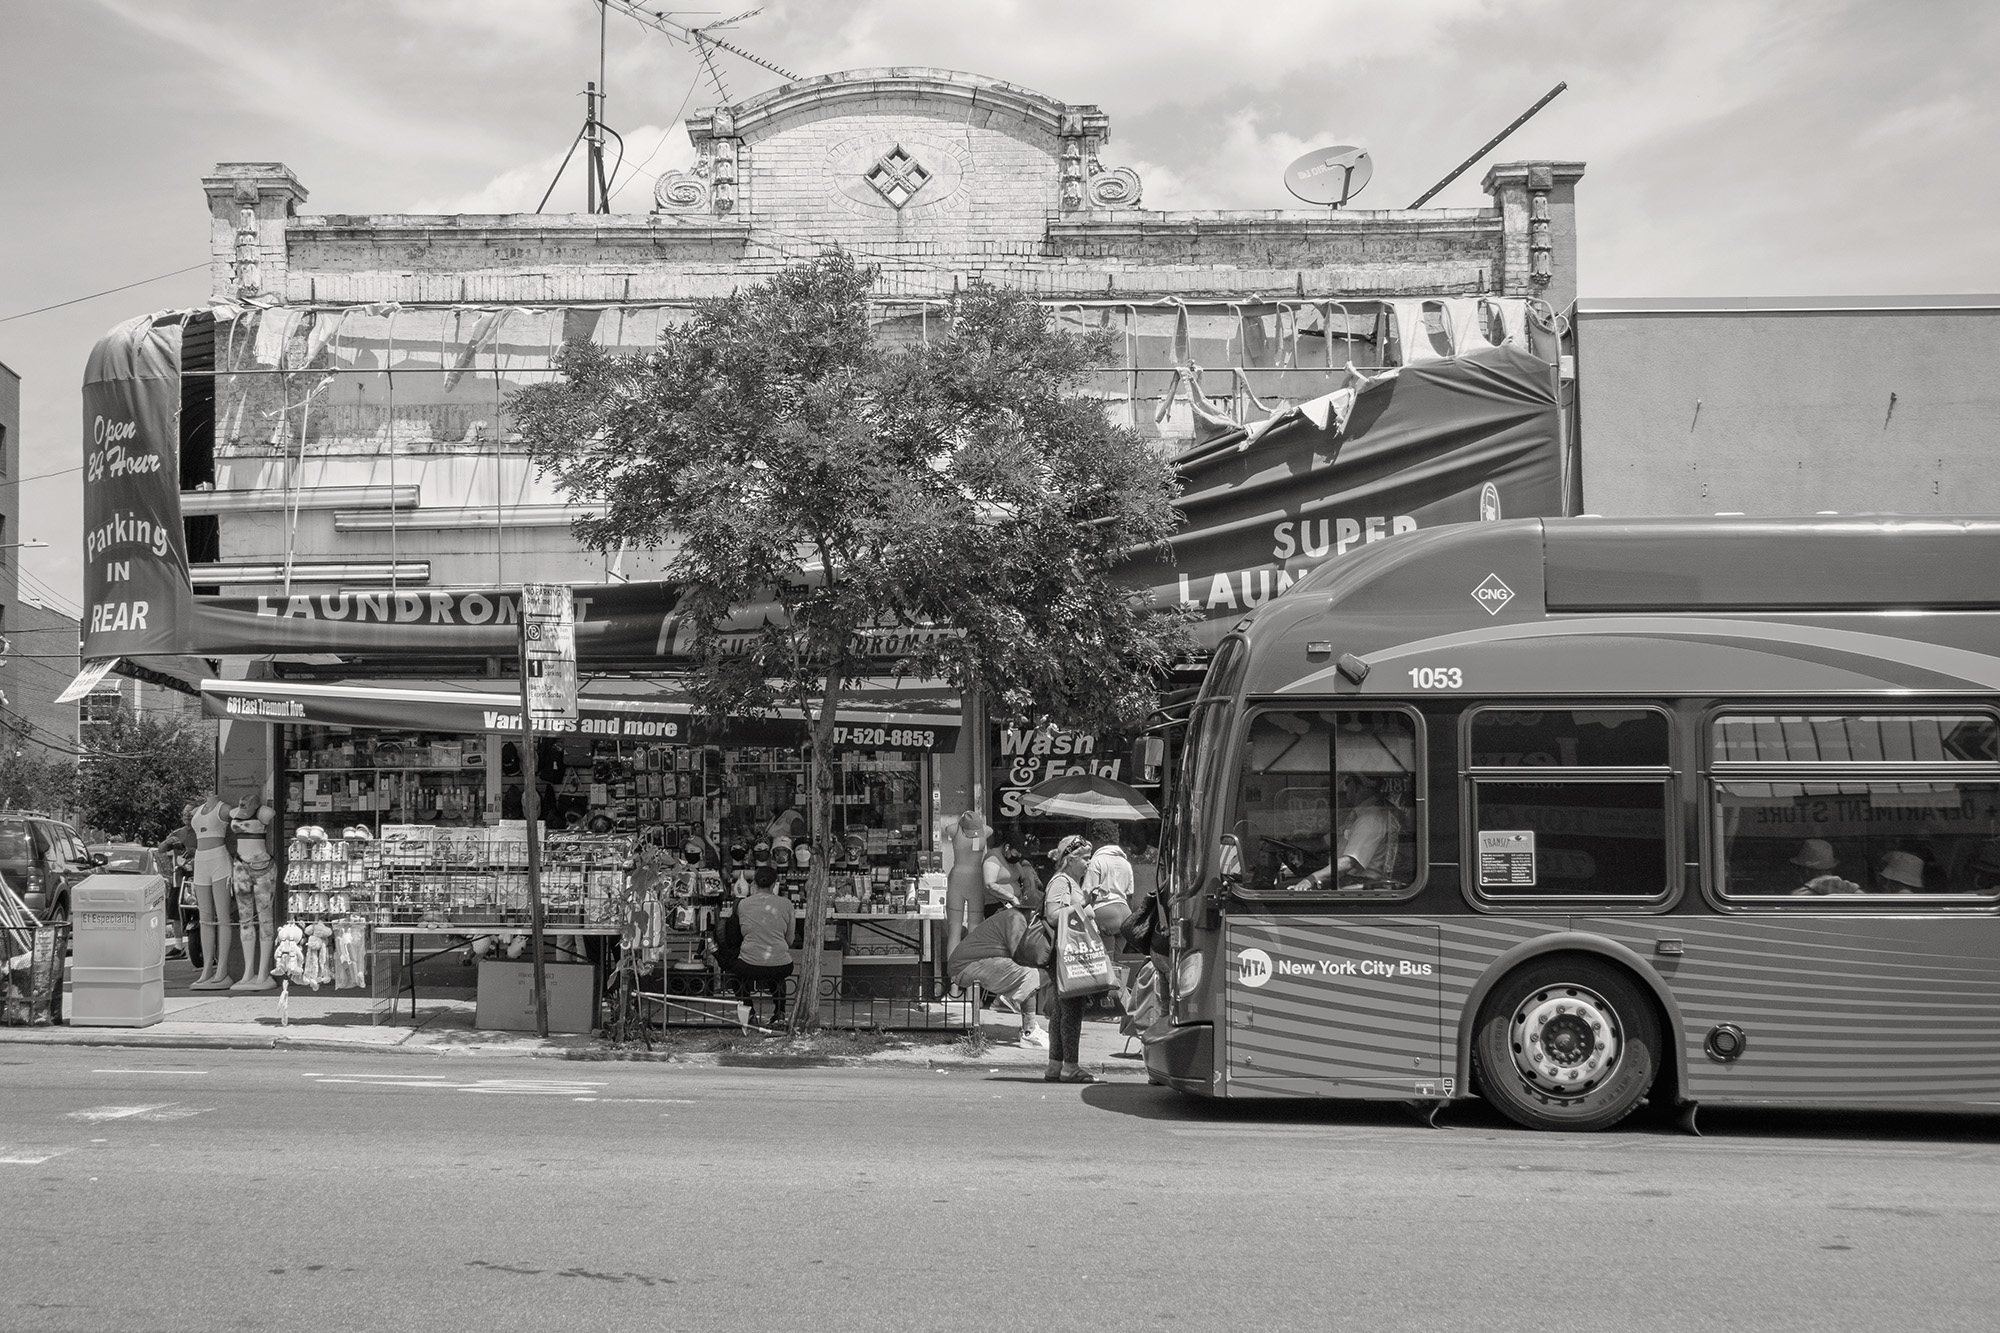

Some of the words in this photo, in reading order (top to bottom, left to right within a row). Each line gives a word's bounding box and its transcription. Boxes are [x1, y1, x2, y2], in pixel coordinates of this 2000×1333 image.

[94, 415, 136, 451] Open
[88, 451, 104, 482] 24
[106, 445, 160, 478] Hour
[88, 511, 167, 563] Parking
[107, 561, 130, 582] IN
[1478, 588, 1508, 600] CNG
[90, 601, 149, 633] REAR
[257, 593, 593, 624] LAUNDROMT
[1408, 667, 1463, 689] 1053
[226, 697, 241, 714] 681
[241, 698, 257, 715] East
[257, 699, 289, 717] Tremont
[290, 700, 306, 718] Ave.
[581, 718, 619, 735] and
[623, 720, 678, 737] more
[1009, 757, 1041, 787] &
[82, 913, 90, 924] El
[1238, 956, 1268, 978] MTA
[1278, 960, 1315, 975] New
[1318, 960, 1357, 975] York
[1360, 960, 1395, 978] City
[1399, 960, 1432, 975] Bus
